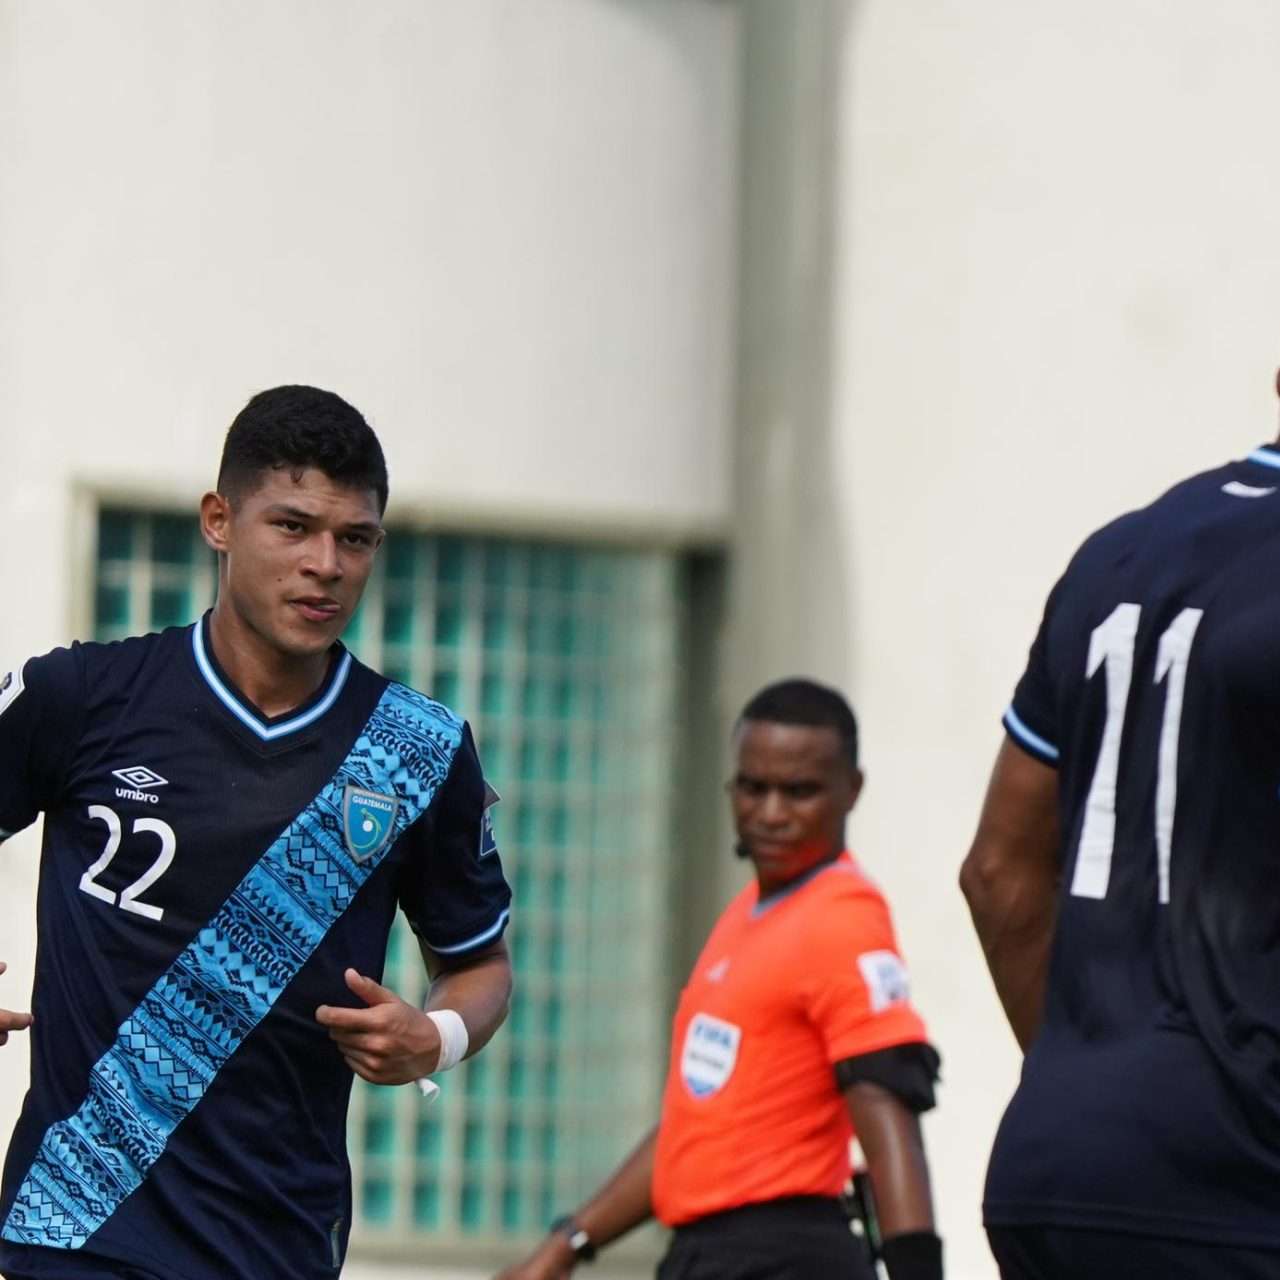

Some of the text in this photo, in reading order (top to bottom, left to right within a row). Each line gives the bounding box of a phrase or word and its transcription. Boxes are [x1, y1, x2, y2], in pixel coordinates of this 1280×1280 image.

[1071, 602, 1203, 905] 11
[115, 787, 159, 804] umbro
[352, 795, 393, 812] GUATEMALA
[79, 804, 177, 922] 22
